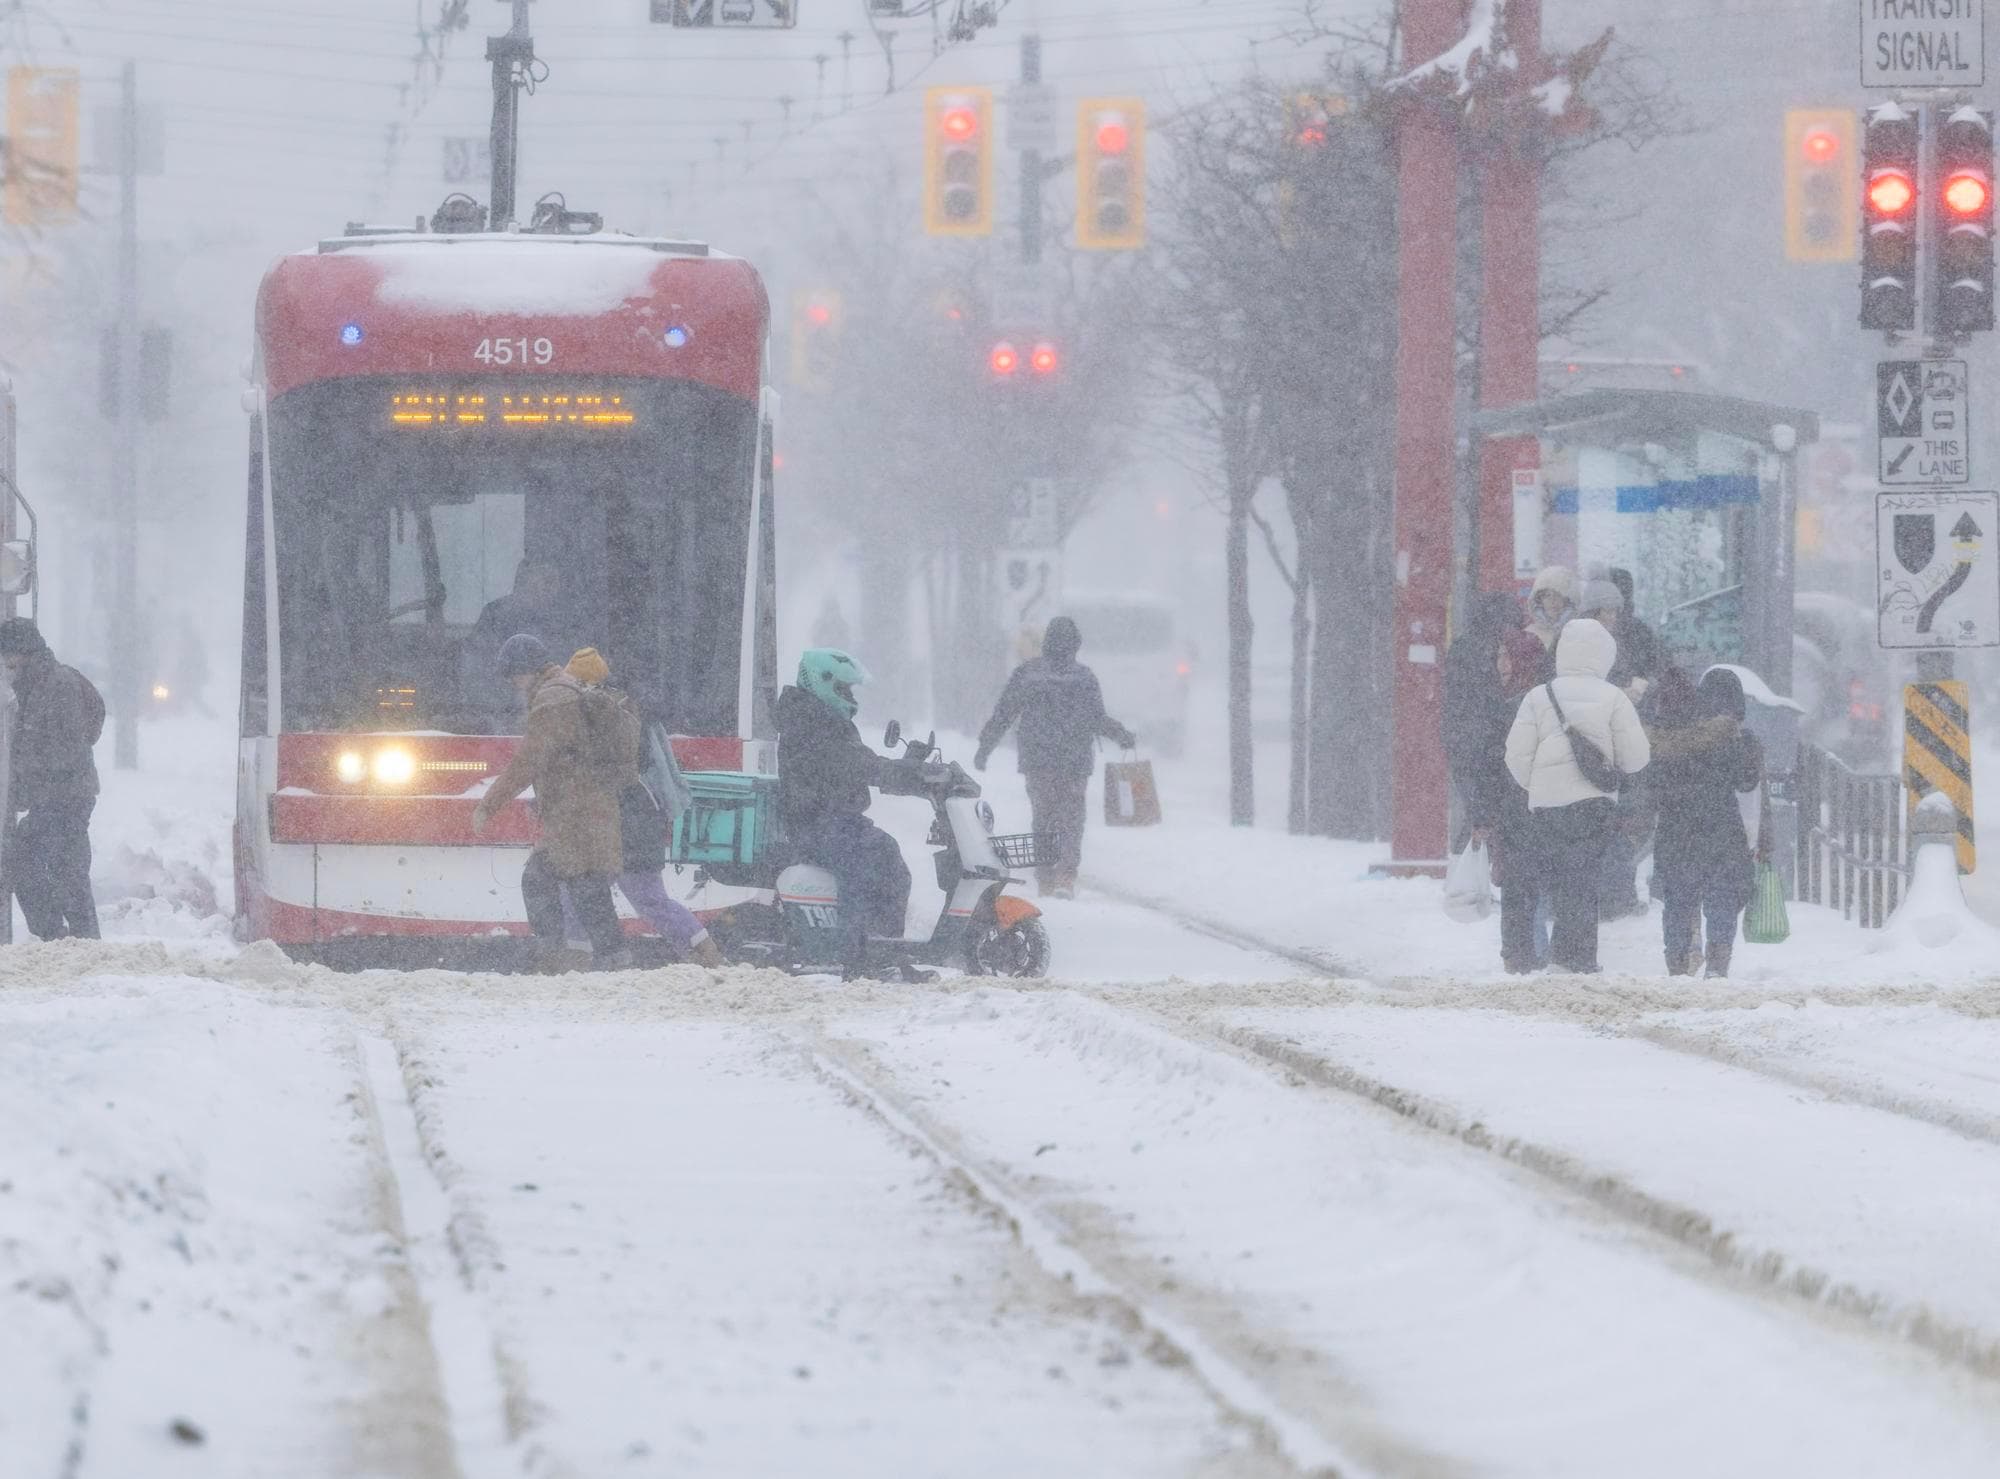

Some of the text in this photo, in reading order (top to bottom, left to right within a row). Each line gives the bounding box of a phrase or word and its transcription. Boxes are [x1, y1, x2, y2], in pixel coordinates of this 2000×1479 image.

[1875, 31, 1970, 71] SIGNAL
[474, 337, 553, 365] 4519
[1923, 440, 1959, 456] THIS
[1919, 460, 1964, 476] LANE
